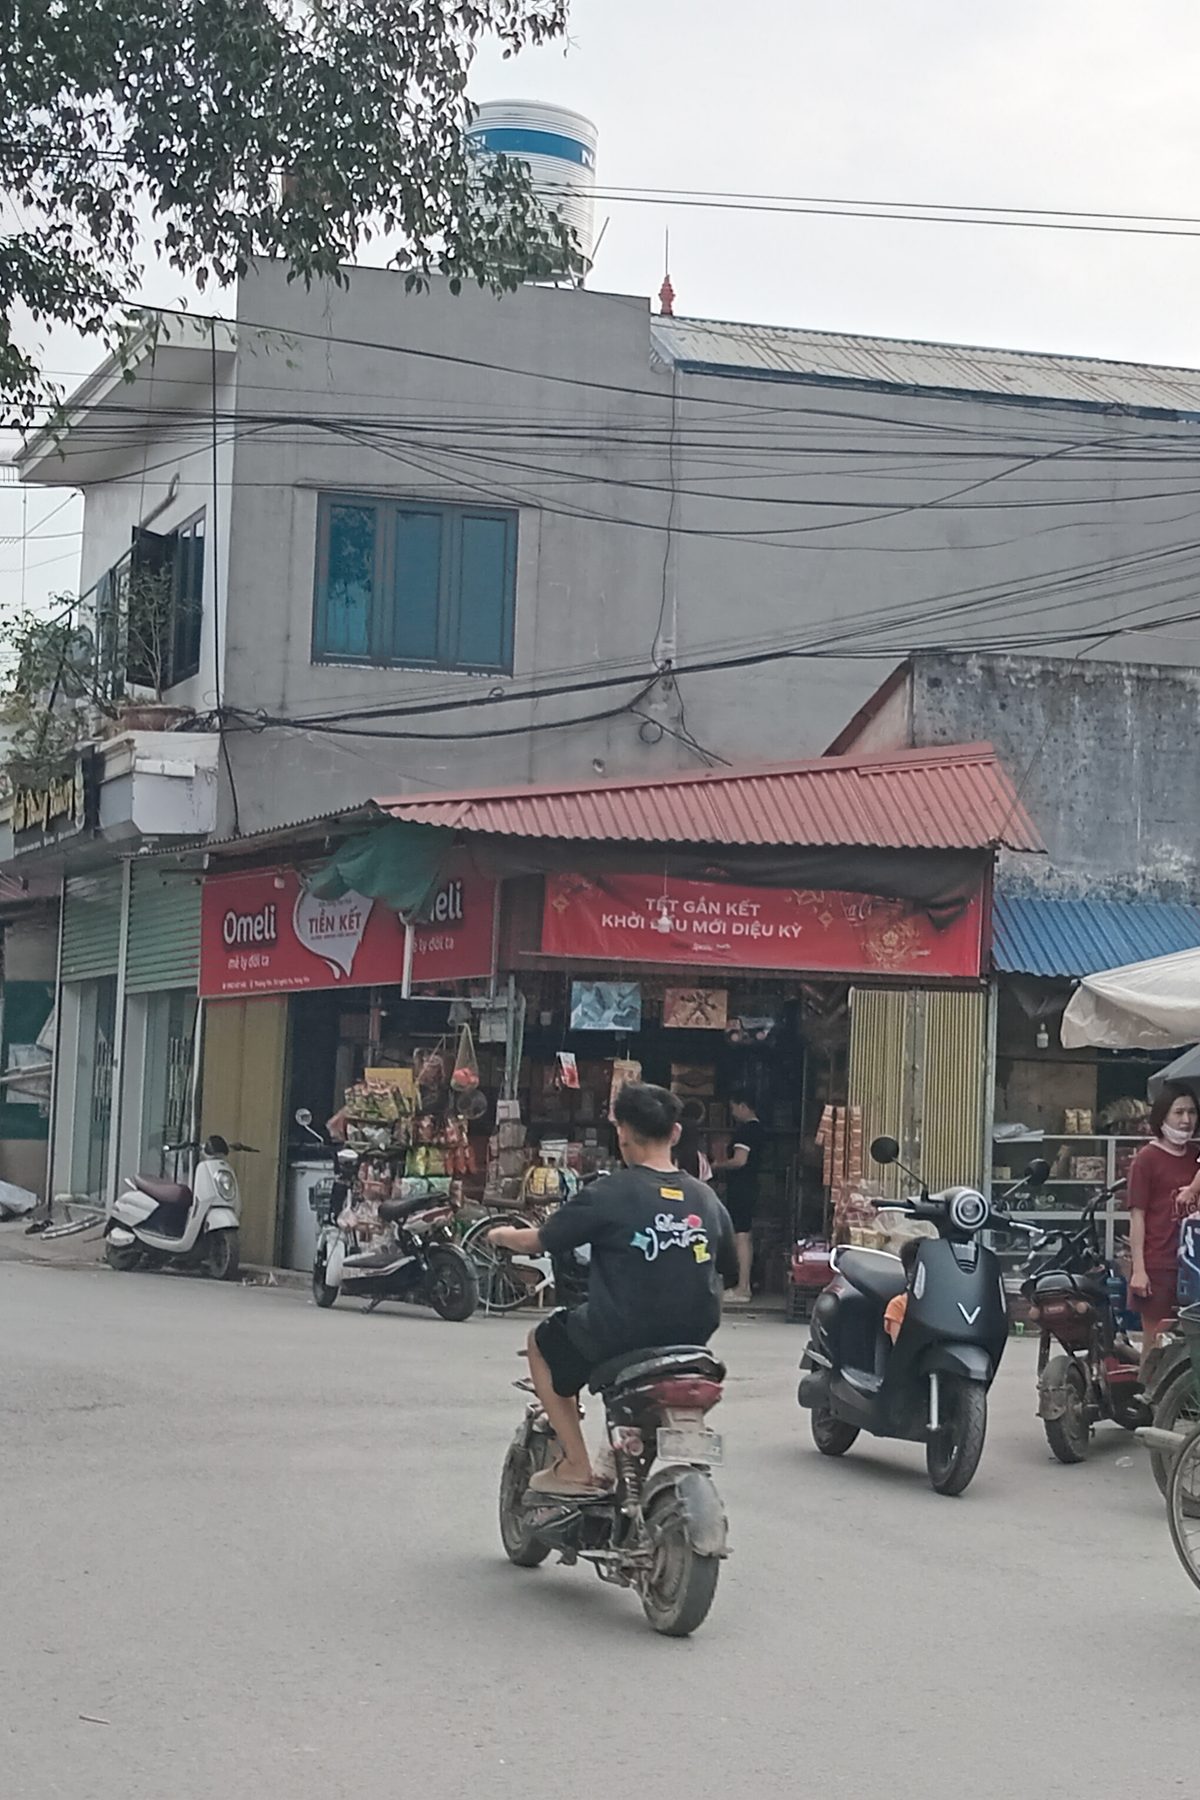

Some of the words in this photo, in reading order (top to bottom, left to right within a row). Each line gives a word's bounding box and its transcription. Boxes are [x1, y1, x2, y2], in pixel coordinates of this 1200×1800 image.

[339, 905, 362, 931] KẾT
[726, 898, 761, 917] KẾT
[224, 904, 276, 945] Omeli
[601, 912, 645, 929] KHỞI
[693, 918, 726, 935] MỚI
[732, 921, 774, 939] DIỆU
[778, 922, 803, 939] KỲ
